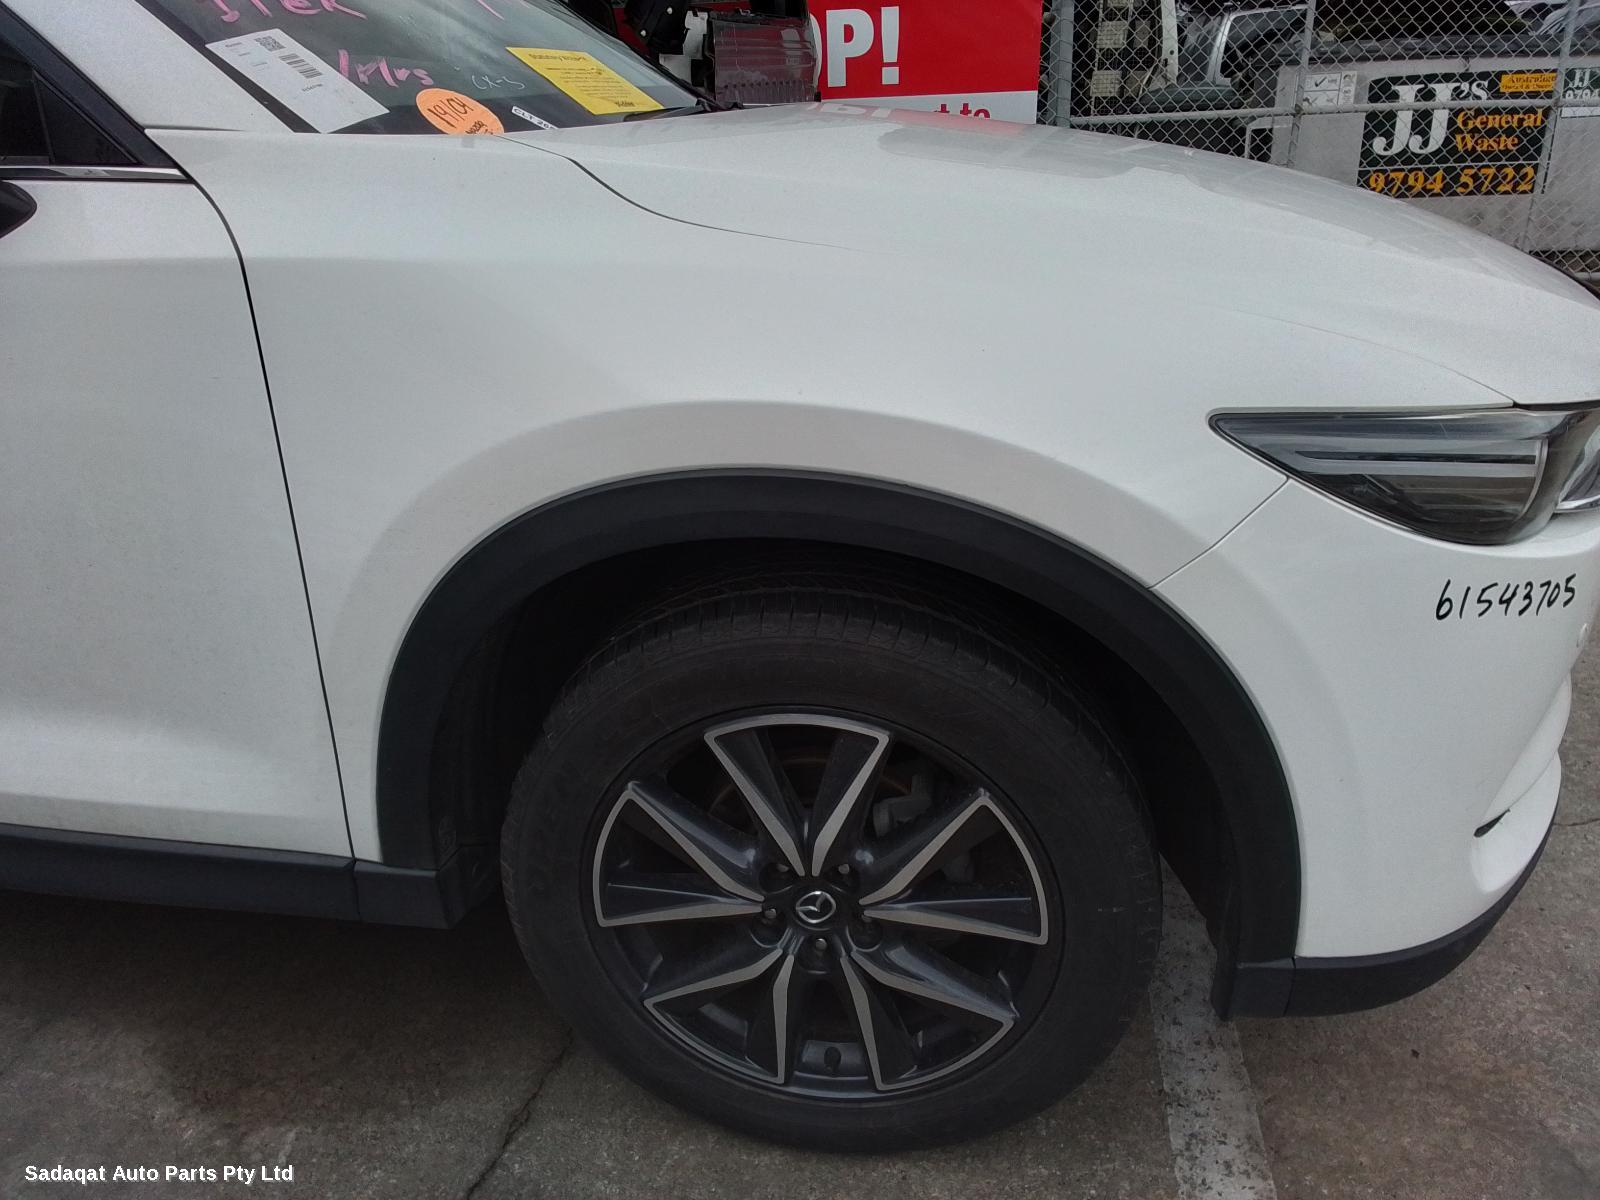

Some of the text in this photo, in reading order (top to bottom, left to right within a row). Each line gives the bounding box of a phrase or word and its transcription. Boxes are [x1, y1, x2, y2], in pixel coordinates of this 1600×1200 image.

[1457, 107, 1543, 129] General
[1455, 132, 1519, 151] Waste
[1368, 166, 1536, 195] 9794 5722
[1435, 573, 1577, 621] 61543705
